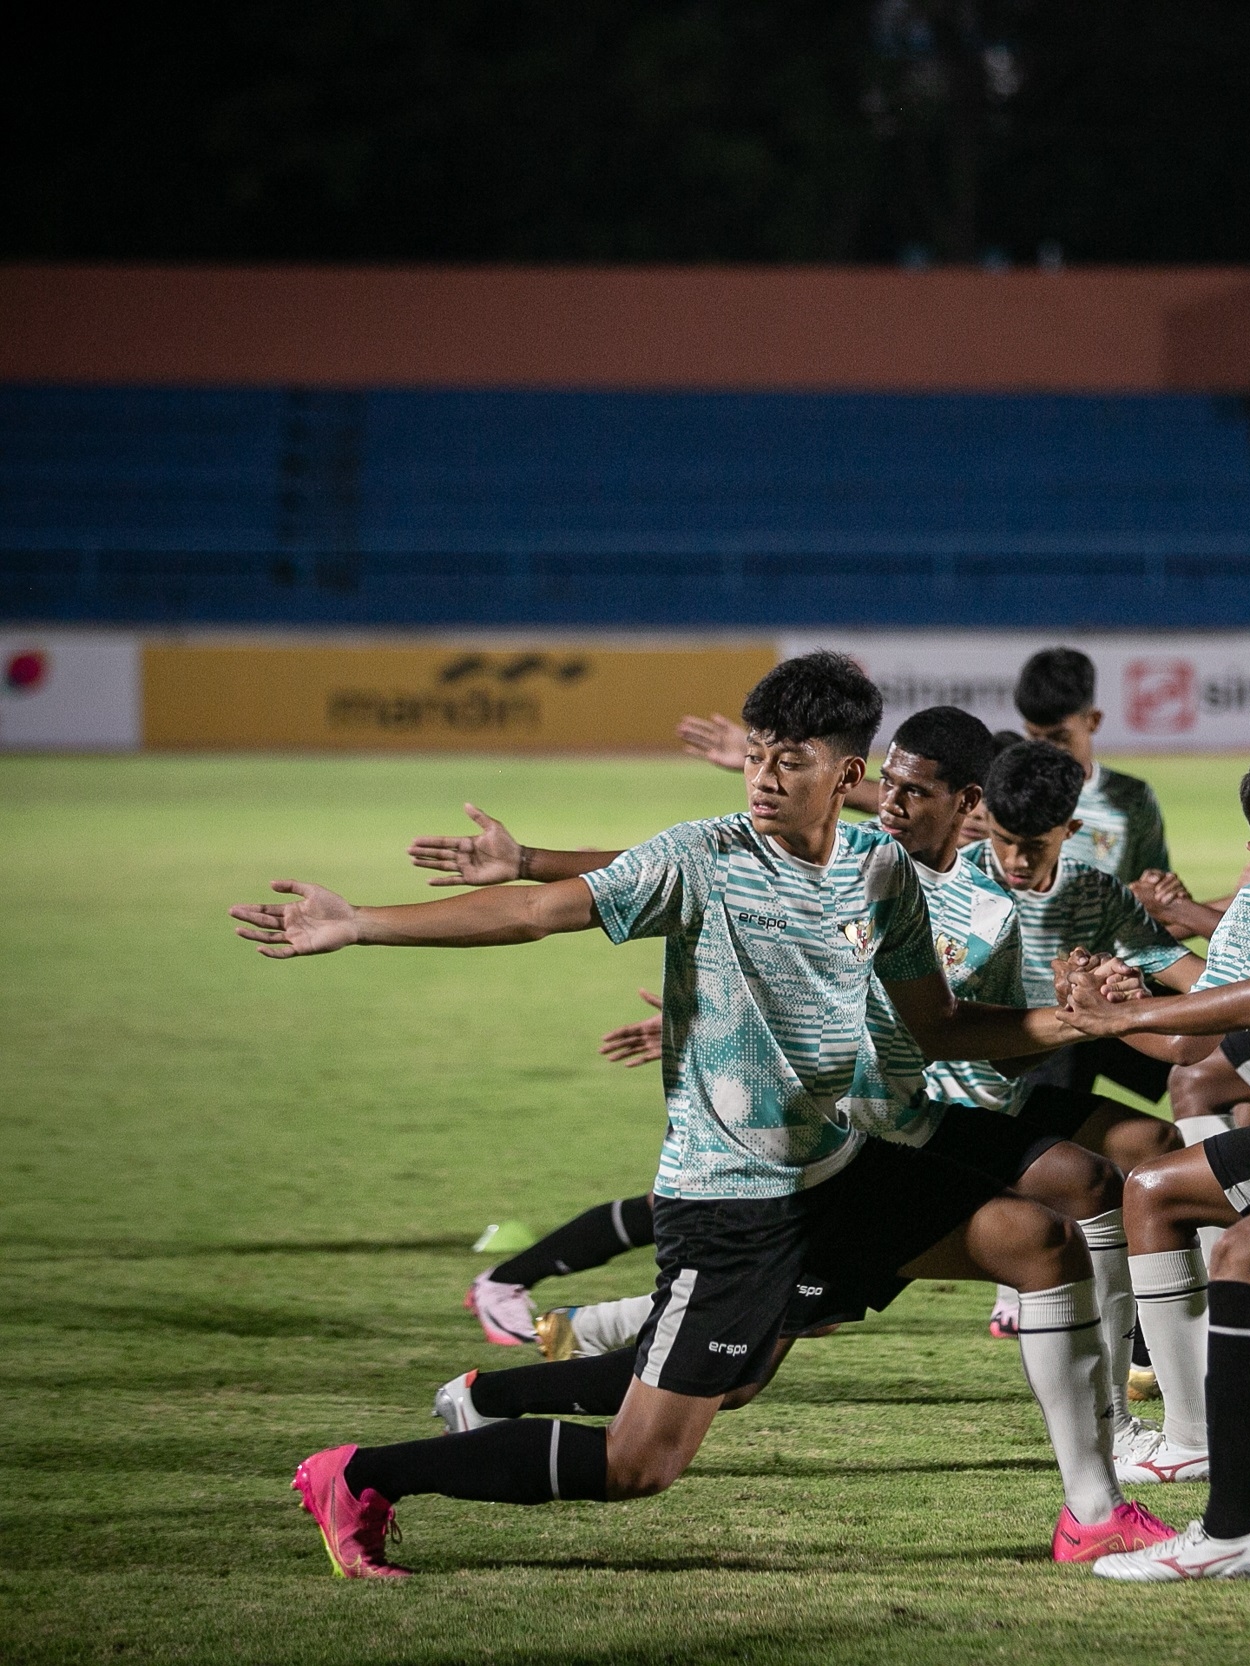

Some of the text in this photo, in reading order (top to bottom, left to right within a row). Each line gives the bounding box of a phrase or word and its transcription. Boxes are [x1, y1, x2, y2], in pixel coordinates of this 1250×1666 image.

[738, 912, 787, 930] erspo
[797, 1284, 823, 1297] spo
[708, 1341, 748, 1357] erspo
